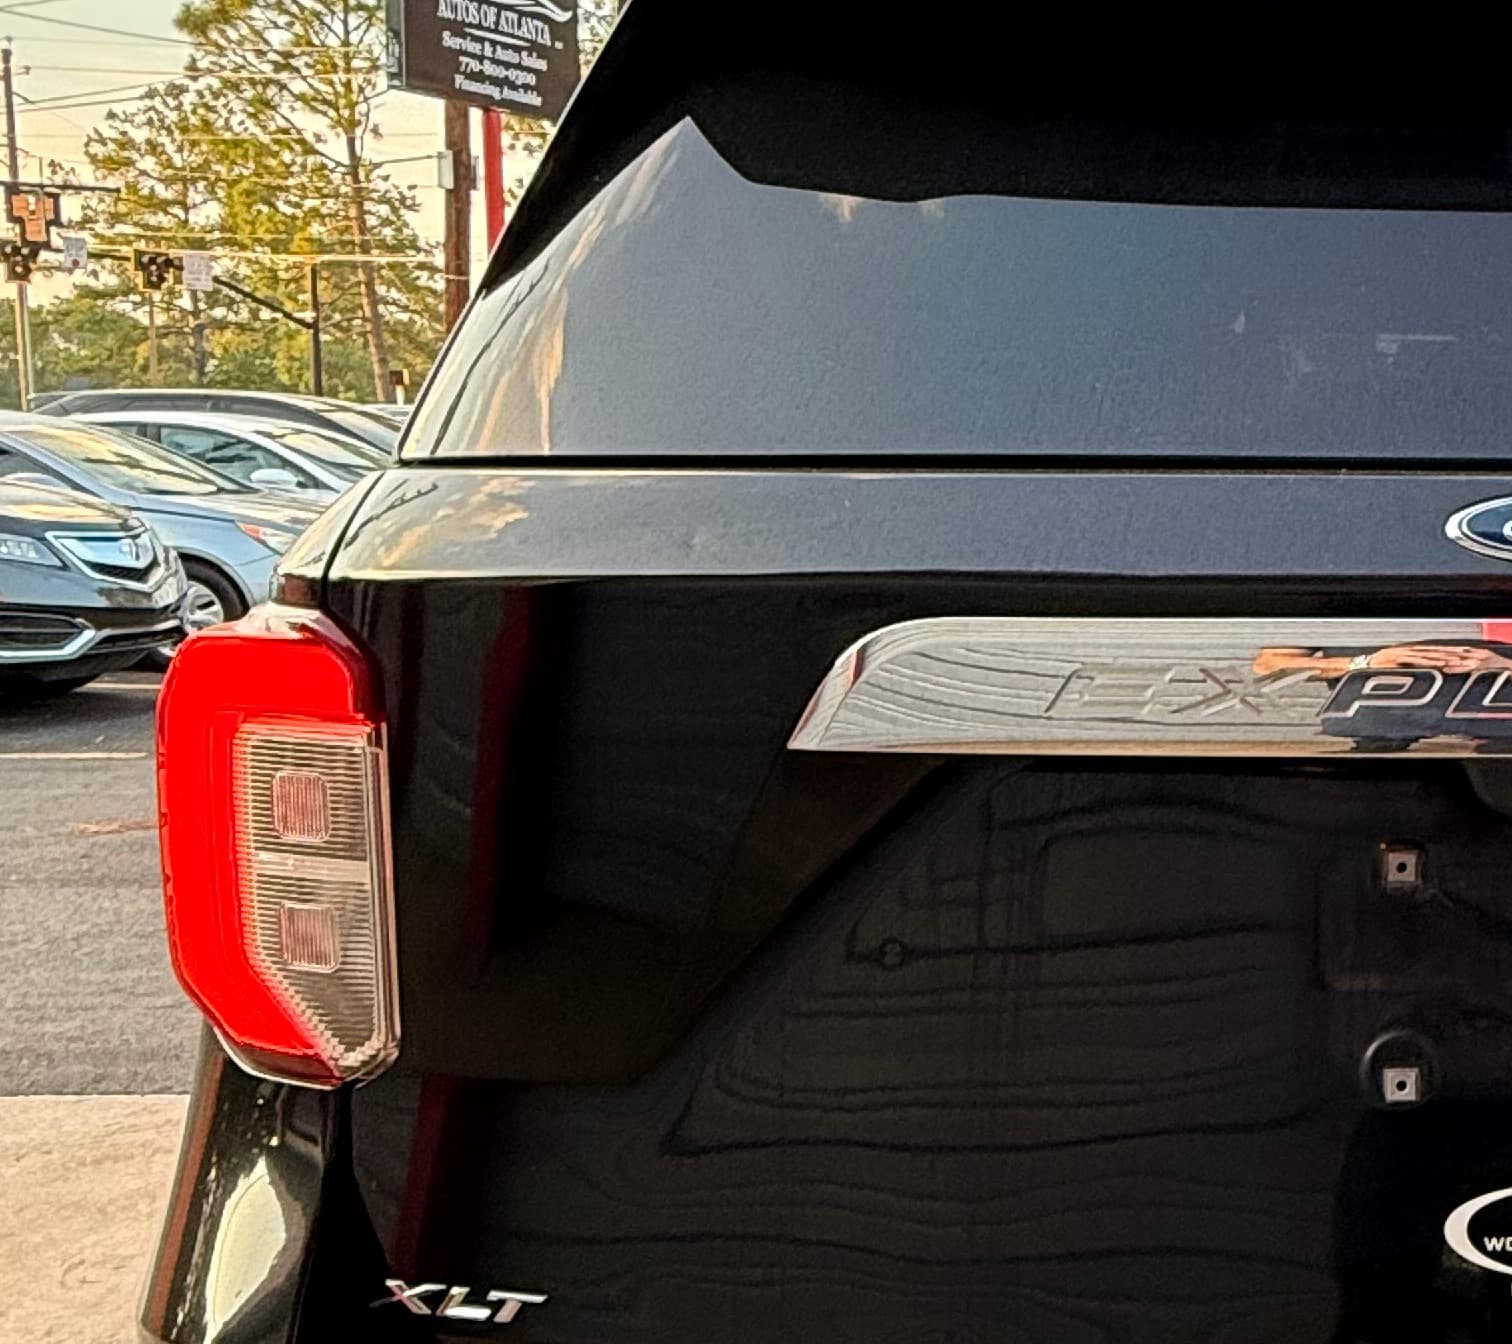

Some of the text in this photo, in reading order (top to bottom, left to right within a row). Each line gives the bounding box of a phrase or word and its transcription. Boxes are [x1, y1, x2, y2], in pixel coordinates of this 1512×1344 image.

[442, 30, 482, 54] Service
[484, 41, 494, 58] &
[480, 4, 497, 29] OF
[498, 10, 551, 46] ATLANTA
[369, 1279, 549, 1323] XLT
